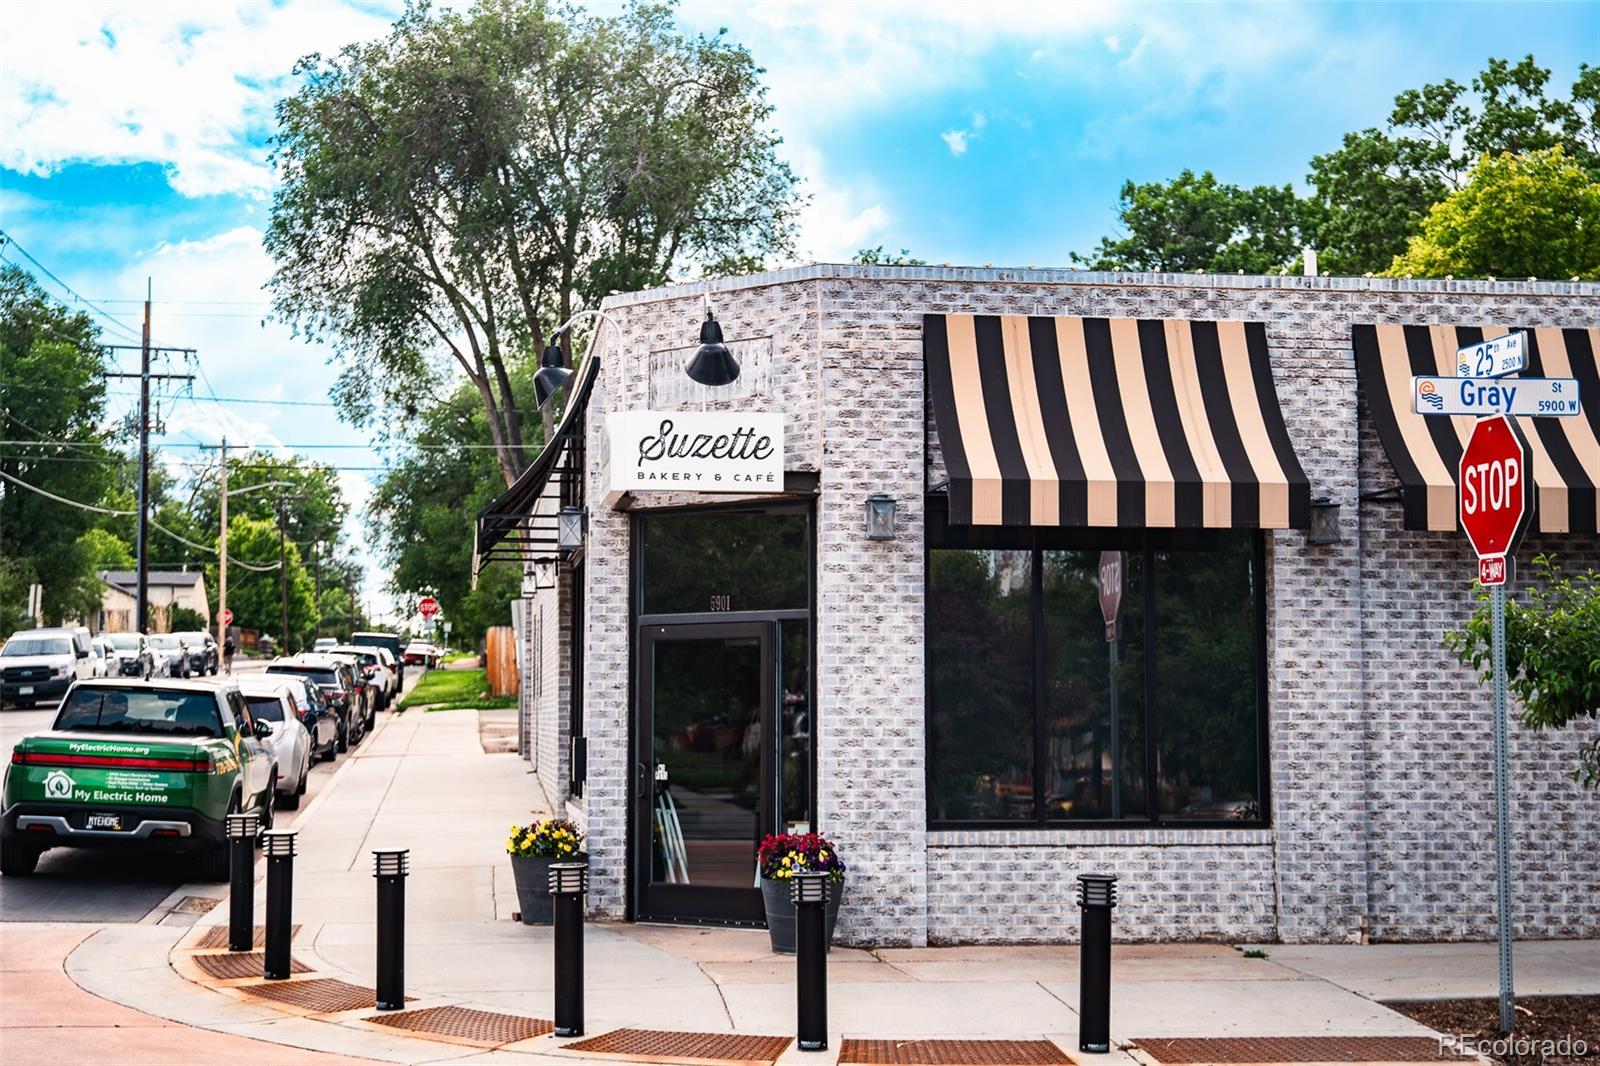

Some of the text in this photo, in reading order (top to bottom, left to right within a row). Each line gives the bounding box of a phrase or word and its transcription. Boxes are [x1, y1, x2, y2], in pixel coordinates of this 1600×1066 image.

[1506, 339, 1517, 349] Ave
[1501, 356, 1522, 370] 2500 N
[1460, 381, 1562, 413] Gray St
[1538, 400, 1577, 412] 5900 W
[638, 419, 774, 467] Suzette
[637, 471, 775, 482] BAKERY & CAFÉ
[1464, 458, 1519, 515] STOP
[1481, 562, 1503, 579] 4-WAY
[420, 602, 436, 612] STOP
[710, 595, 731, 611] 5901
[69, 742, 150, 756] MyElectricHome.org
[74, 789, 168, 803] My Electric Home
